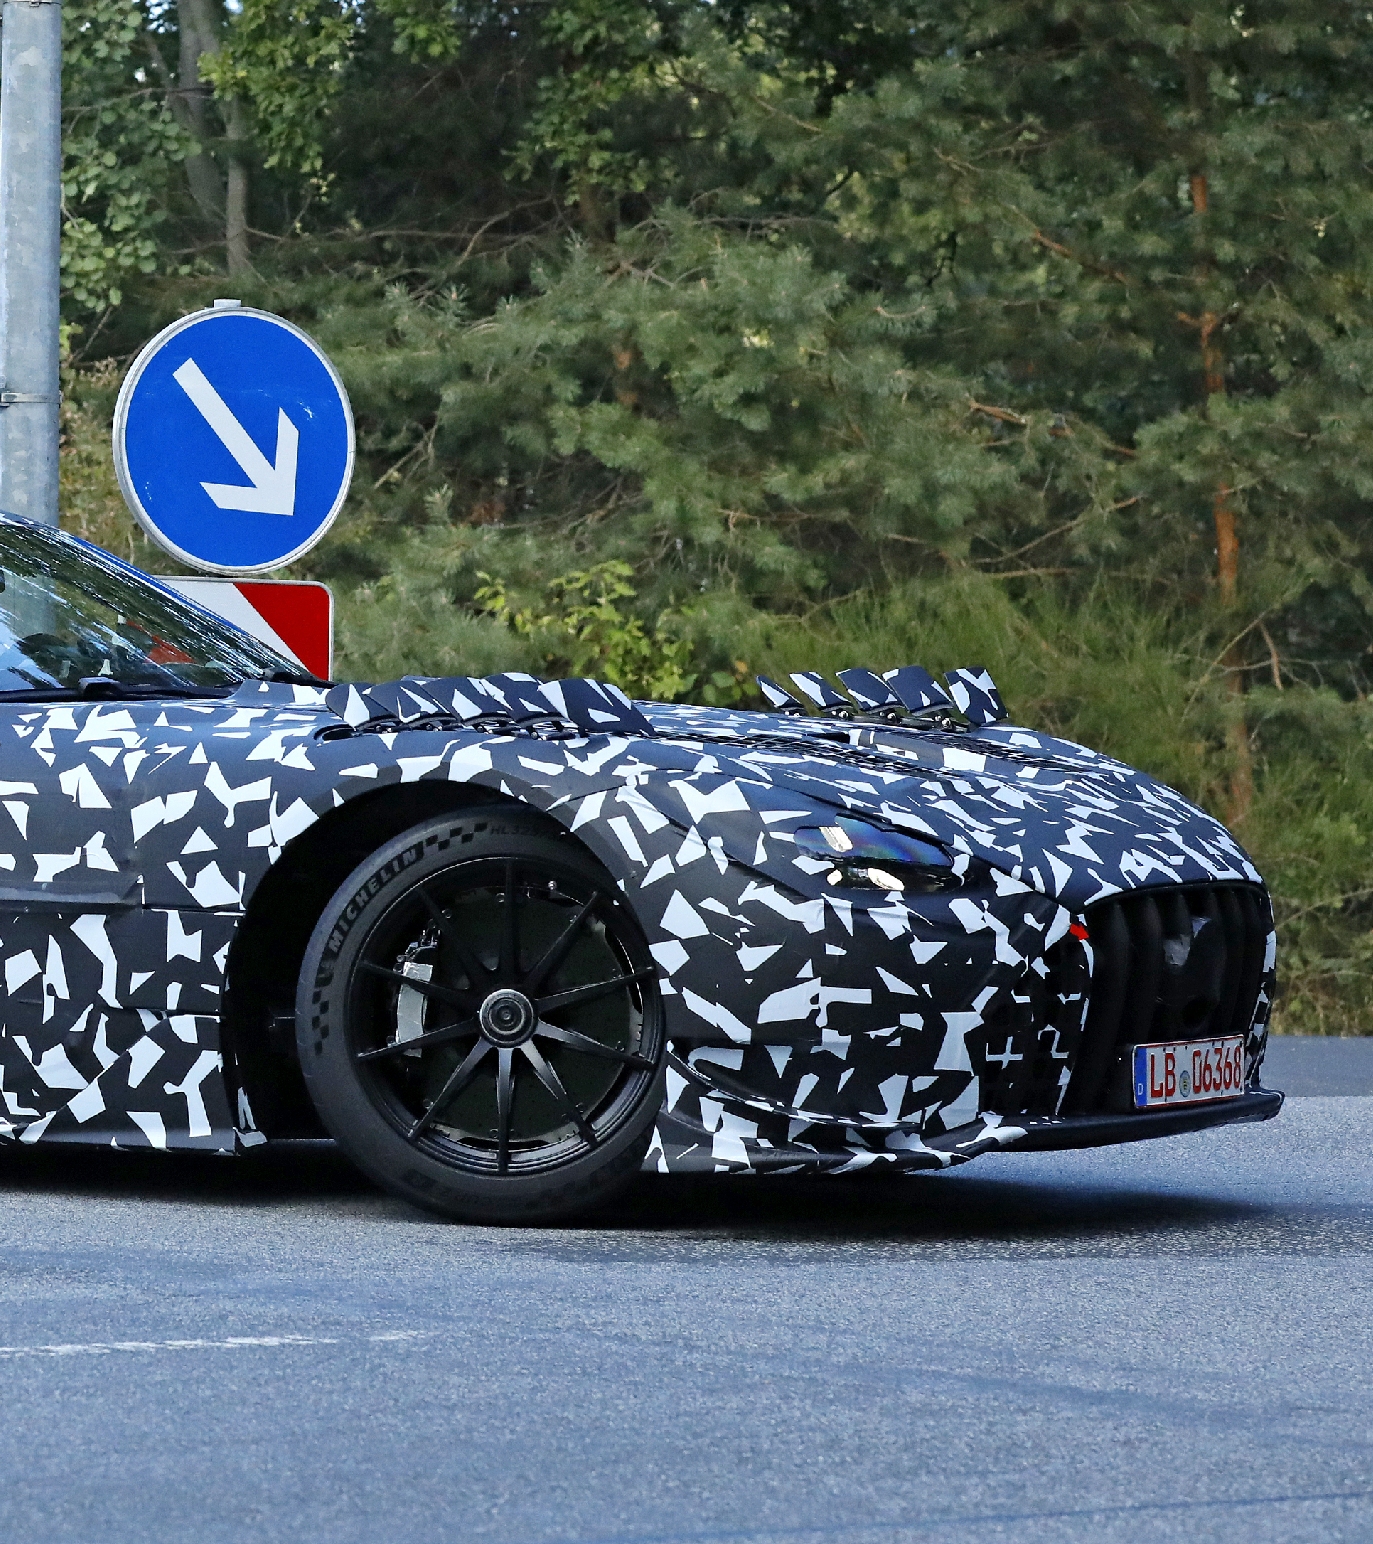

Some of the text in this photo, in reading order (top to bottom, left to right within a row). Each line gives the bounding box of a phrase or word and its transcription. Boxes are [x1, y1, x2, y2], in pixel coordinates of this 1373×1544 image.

[327, 847, 417, 954] MICHELIN
[1137, 1083, 1144, 1096] D
[1150, 1052, 1176, 1098] LB
[1192, 1045, 1242, 1094] 06368
